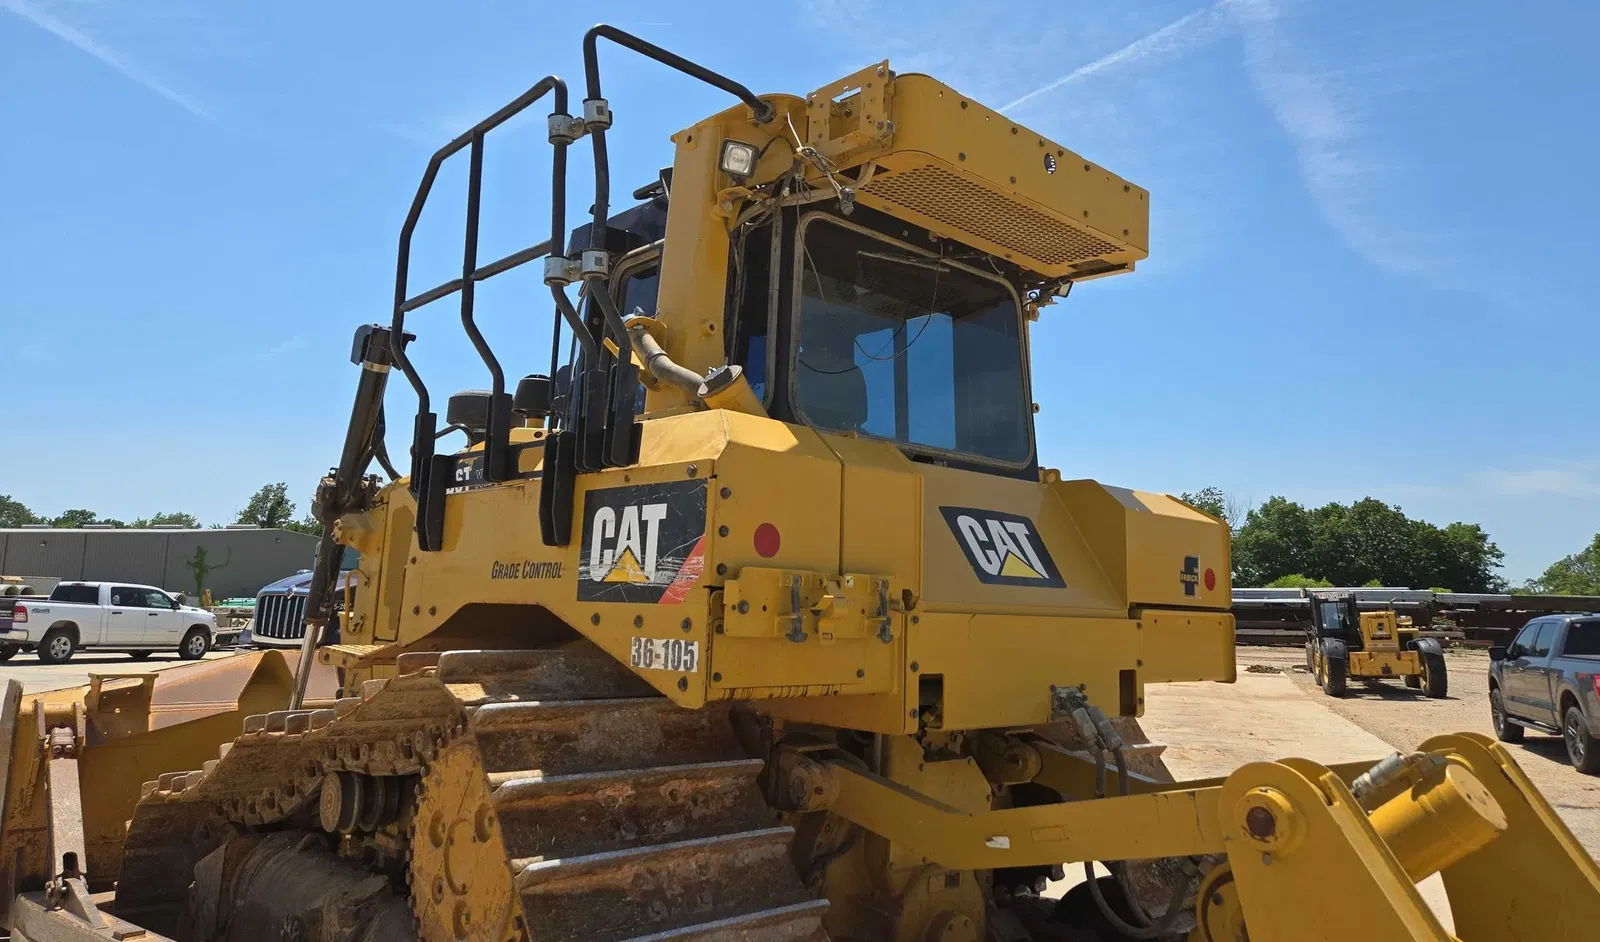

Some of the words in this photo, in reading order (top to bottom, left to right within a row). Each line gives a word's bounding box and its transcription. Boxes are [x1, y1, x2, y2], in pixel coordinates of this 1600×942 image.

[590, 503, 667, 581] CAT
[956, 515, 1050, 579] CAT
[491, 560, 521, 579] GRADE
[521, 560, 562, 579] CONTROL
[631, 637, 695, 671] 36-105
